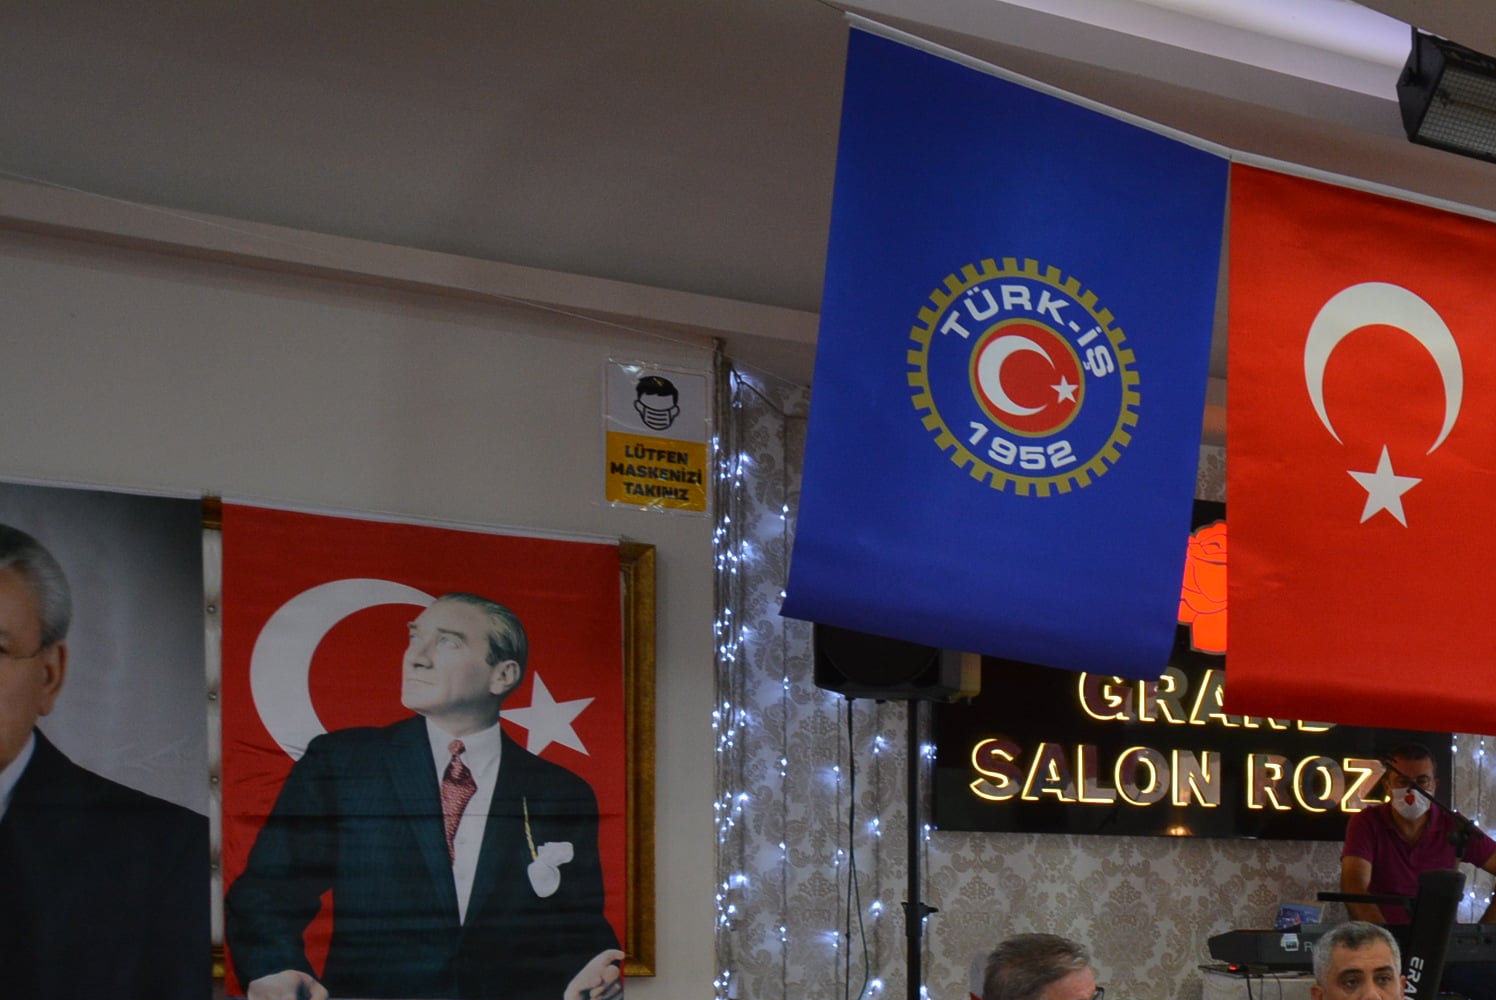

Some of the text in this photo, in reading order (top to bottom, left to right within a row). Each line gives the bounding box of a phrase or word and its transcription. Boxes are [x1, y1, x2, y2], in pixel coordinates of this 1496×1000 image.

[940, 284, 1115, 378] TÜRK-İŞ
[625, 444, 688, 465] LÜTFEN
[968, 421, 1077, 470] 1952
[610, 462, 702, 485] MASKENİZİ
[624, 482, 690, 501] TAKINIZ
[1078, 664, 1337, 732] GRA
[969, 737, 1391, 812] SALON ROZ
